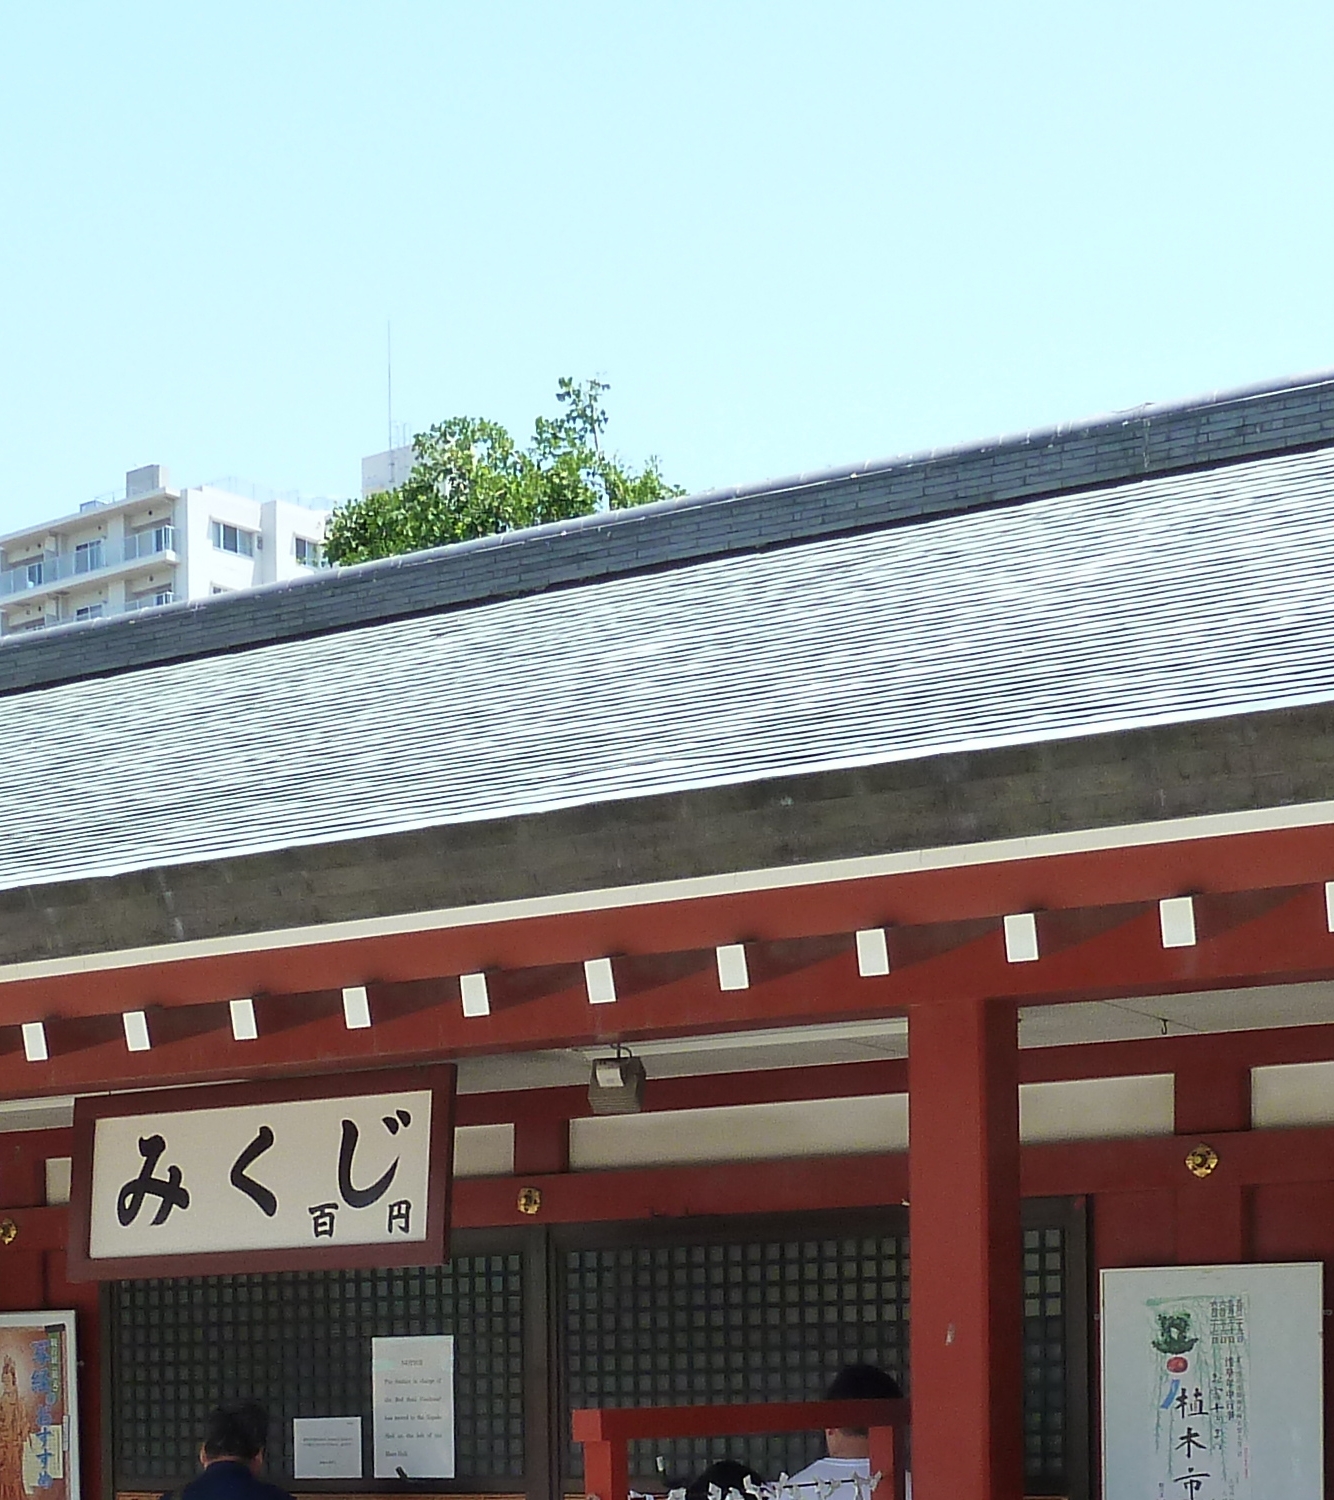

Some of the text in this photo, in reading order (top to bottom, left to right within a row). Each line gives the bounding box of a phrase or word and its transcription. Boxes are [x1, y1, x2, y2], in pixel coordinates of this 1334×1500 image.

[117, 1109, 413, 1227] みくじ
[308, 1199, 412, 1238] 百円
